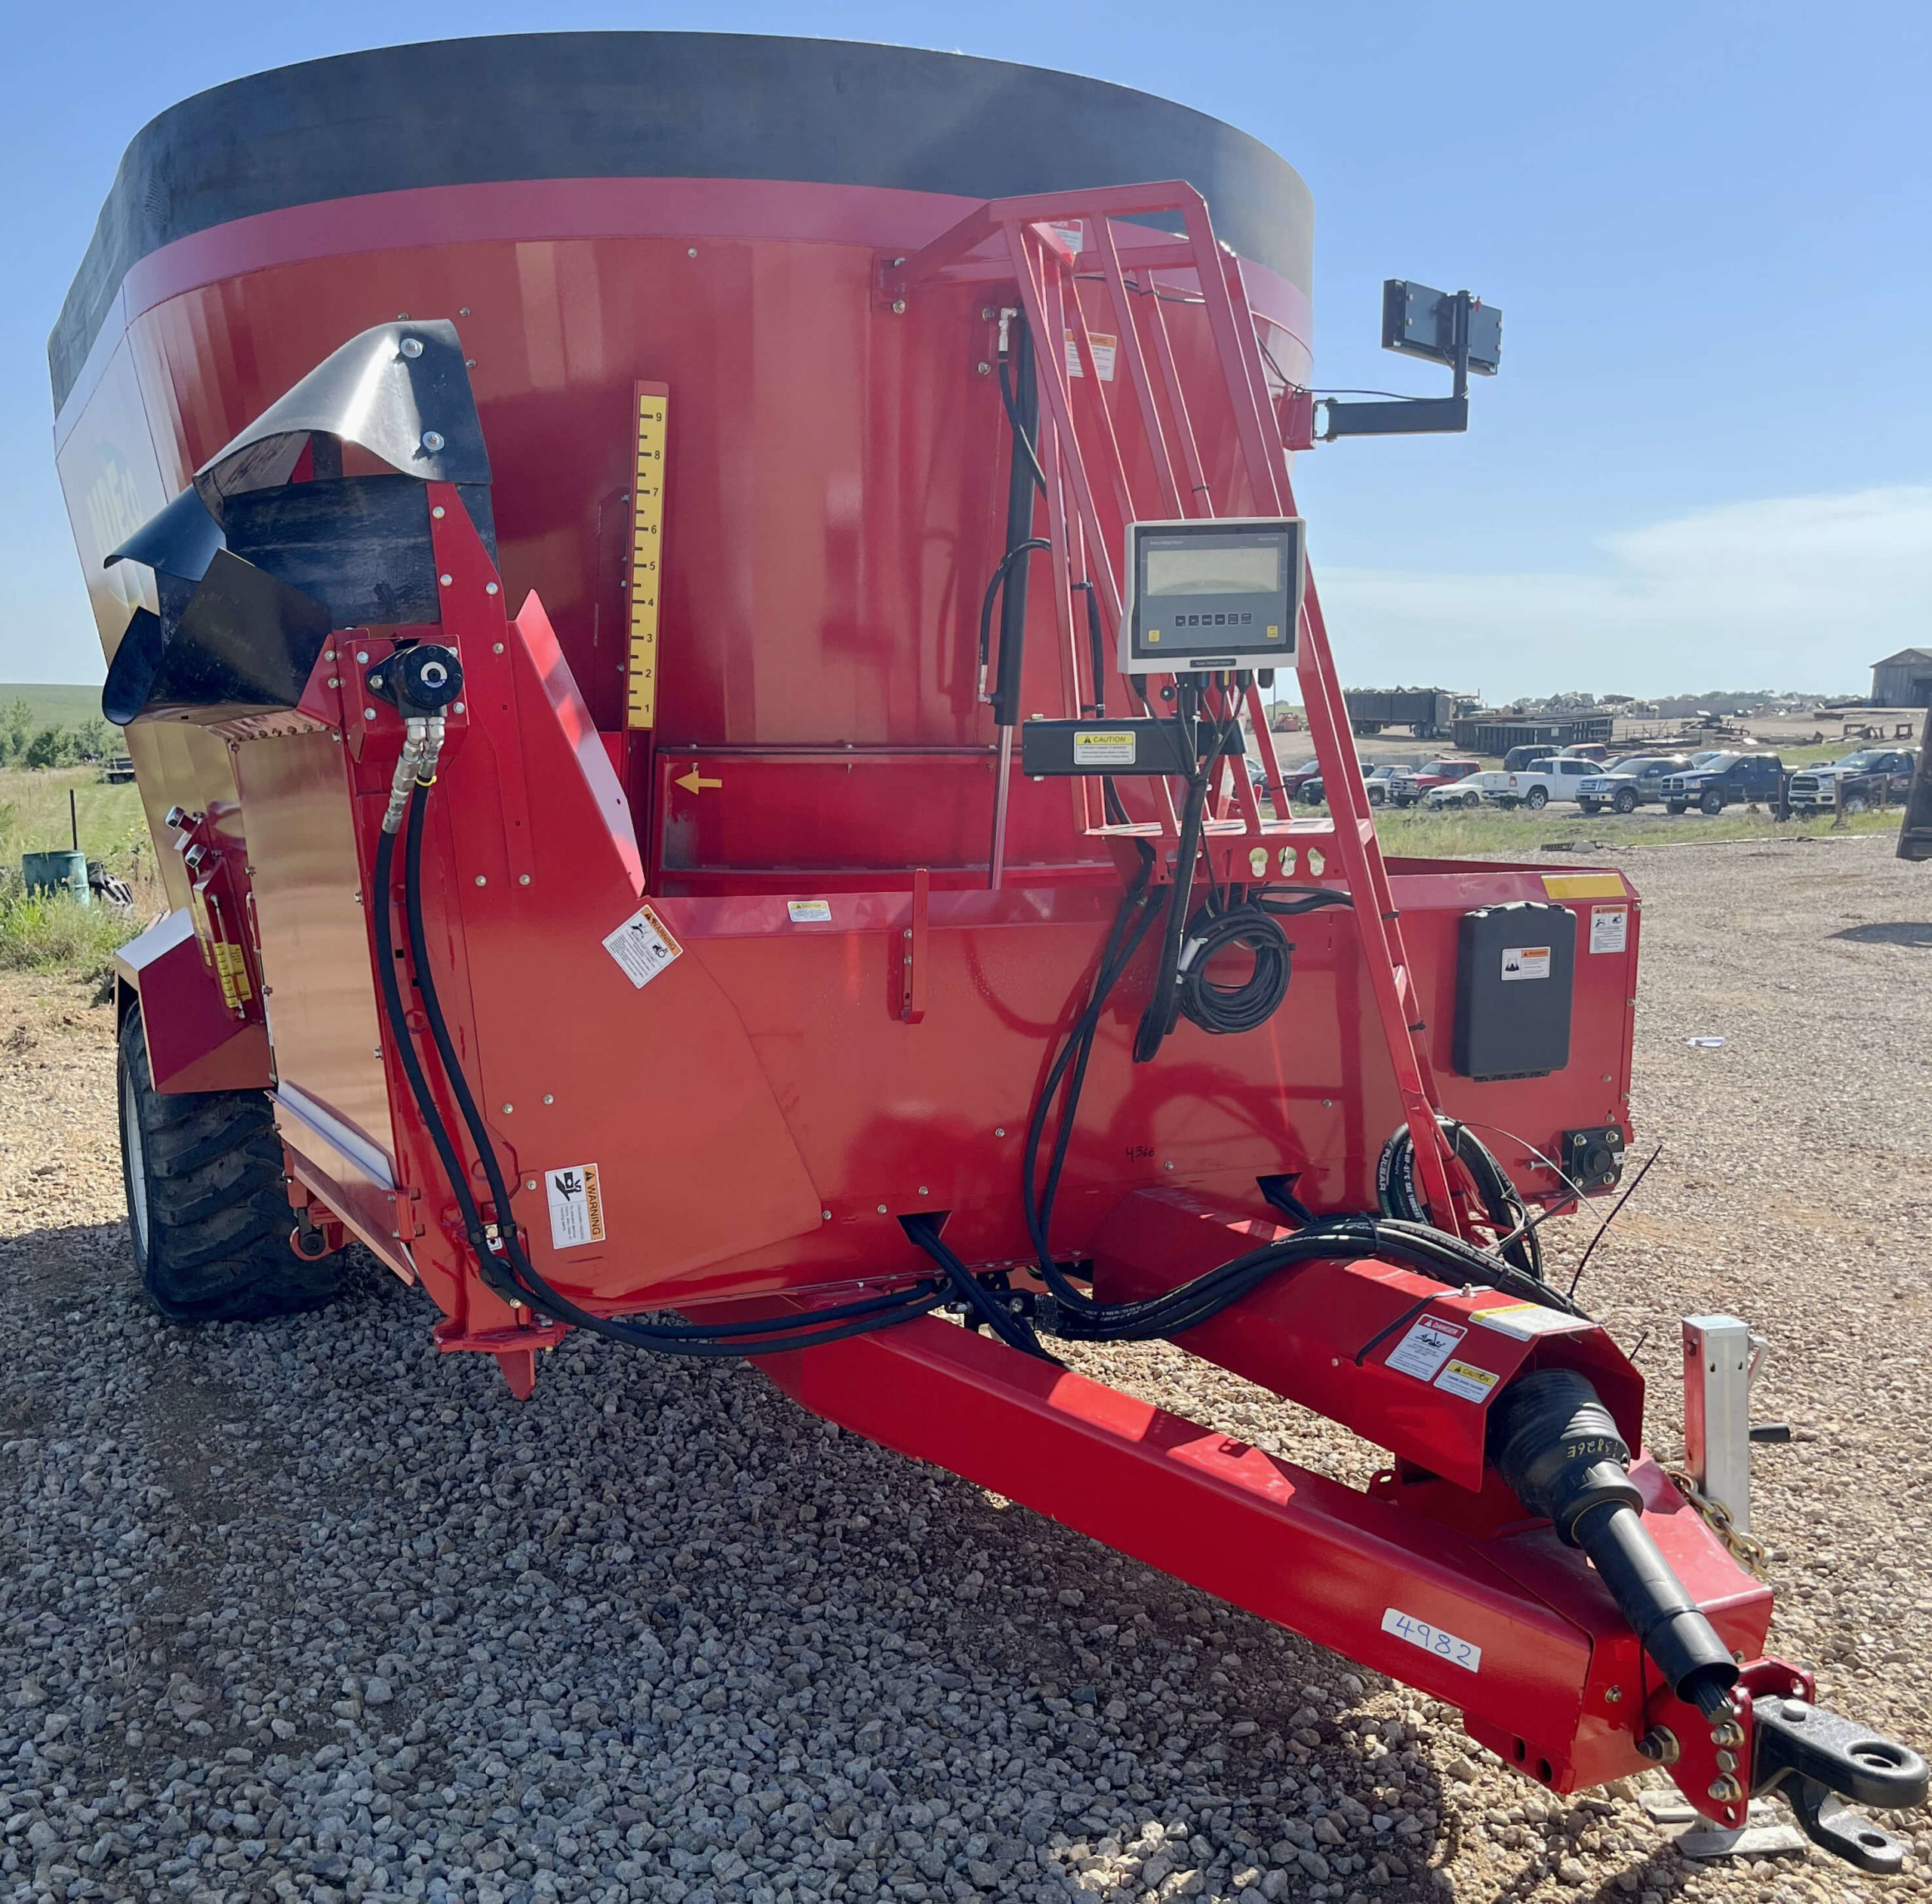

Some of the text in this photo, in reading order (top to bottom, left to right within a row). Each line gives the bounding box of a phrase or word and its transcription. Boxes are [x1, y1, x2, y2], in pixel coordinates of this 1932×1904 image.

[656, 413, 663, 421] 9
[654, 451, 660, 460] 8
[653, 488, 659, 497] 7
[651, 525, 657, 534] 6
[649, 561, 656, 571] 5
[648, 598, 654, 606] 4
[647, 634, 653, 642] 3
[645, 669, 651, 678] 2
[645, 704, 650, 712] 1
[651, 918, 676, 951] WARNING
[1378, 1148, 1392, 1192] PULSAR
[587, 1184, 601, 1235] WARNING
[1432, 1321, 1459, 1335] DANGER
[1462, 1368, 1491, 1383] CAUTION
[1395, 1616, 1470, 1666] 4982
